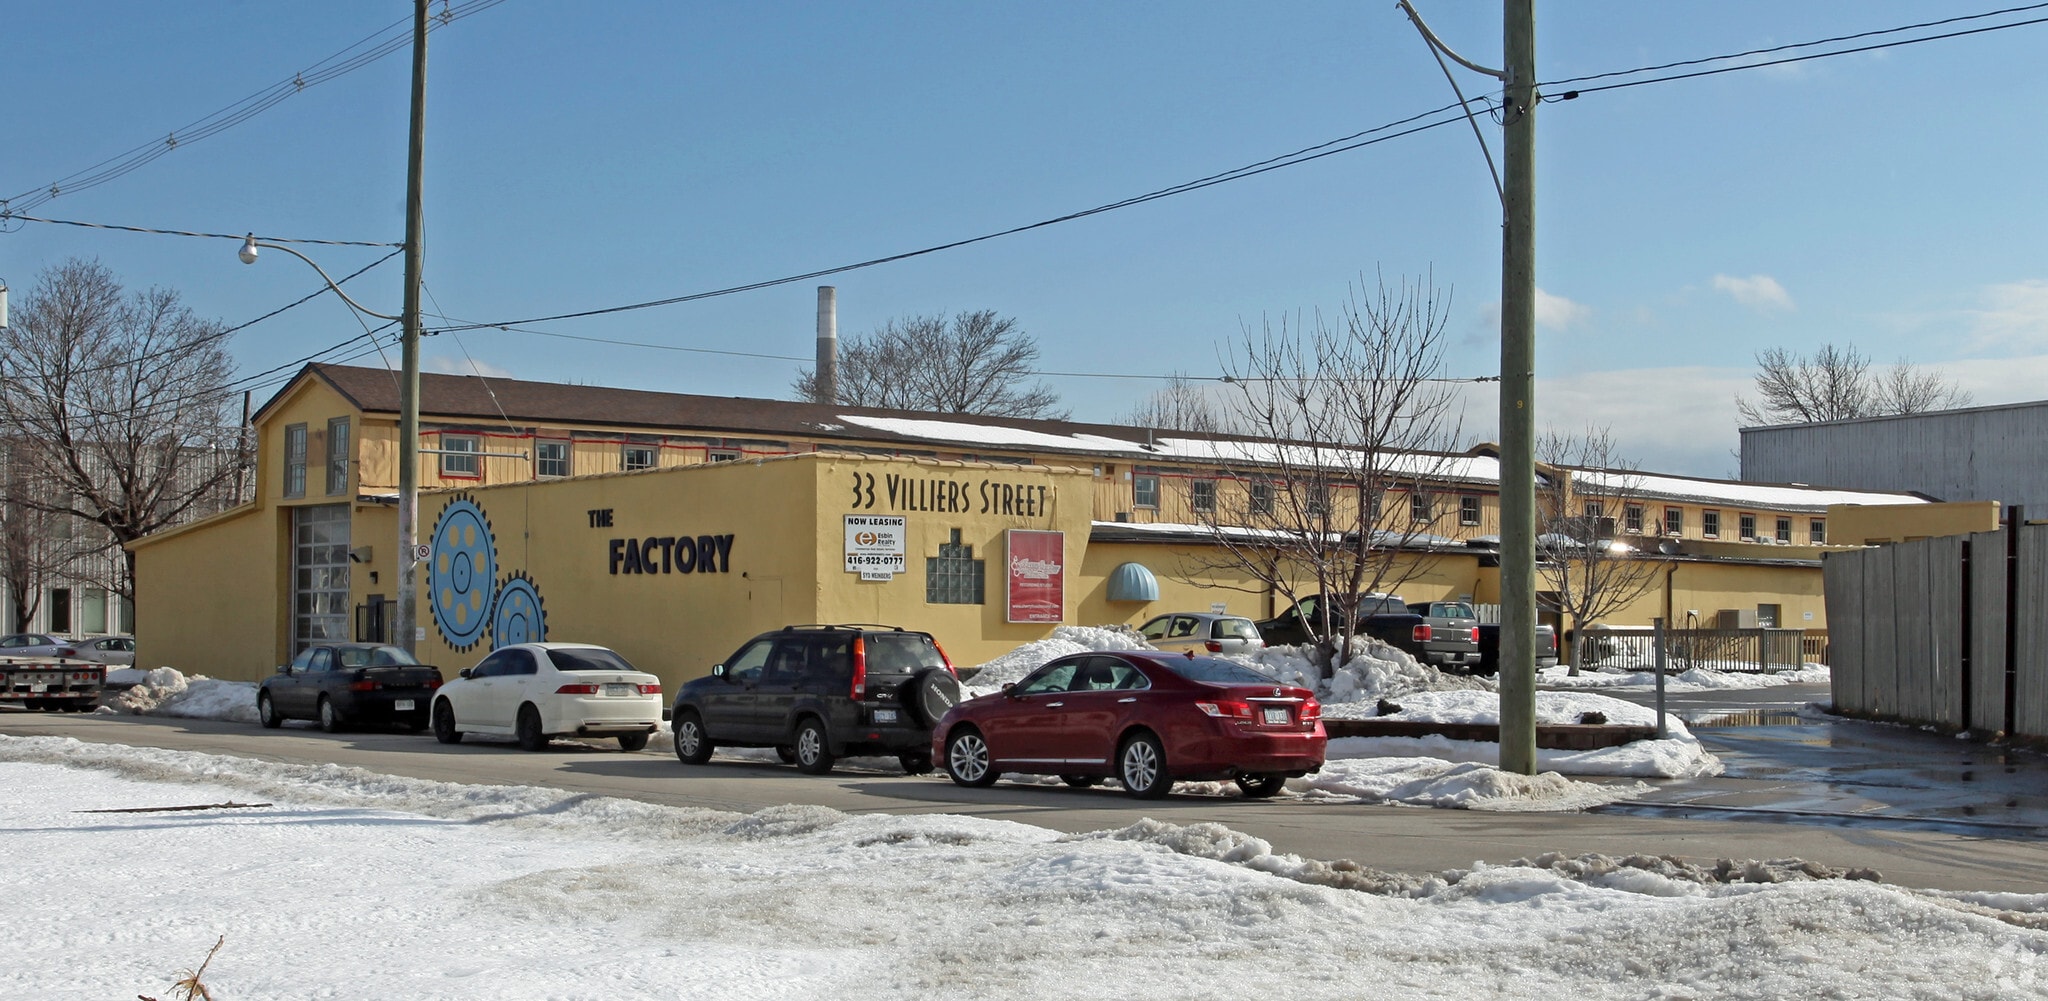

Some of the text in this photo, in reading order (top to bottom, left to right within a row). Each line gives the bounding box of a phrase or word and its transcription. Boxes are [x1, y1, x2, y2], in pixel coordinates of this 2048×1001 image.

[852, 471, 1046, 517] 33 VILLIERS STREET
[587, 508, 614, 528] THE
[848, 517, 903, 526] NOW LEASING
[609, 534, 735, 575] FACTORY
[847, 556, 903, 565] 416-922-0777
[930, 682, 954, 708] HONDA
